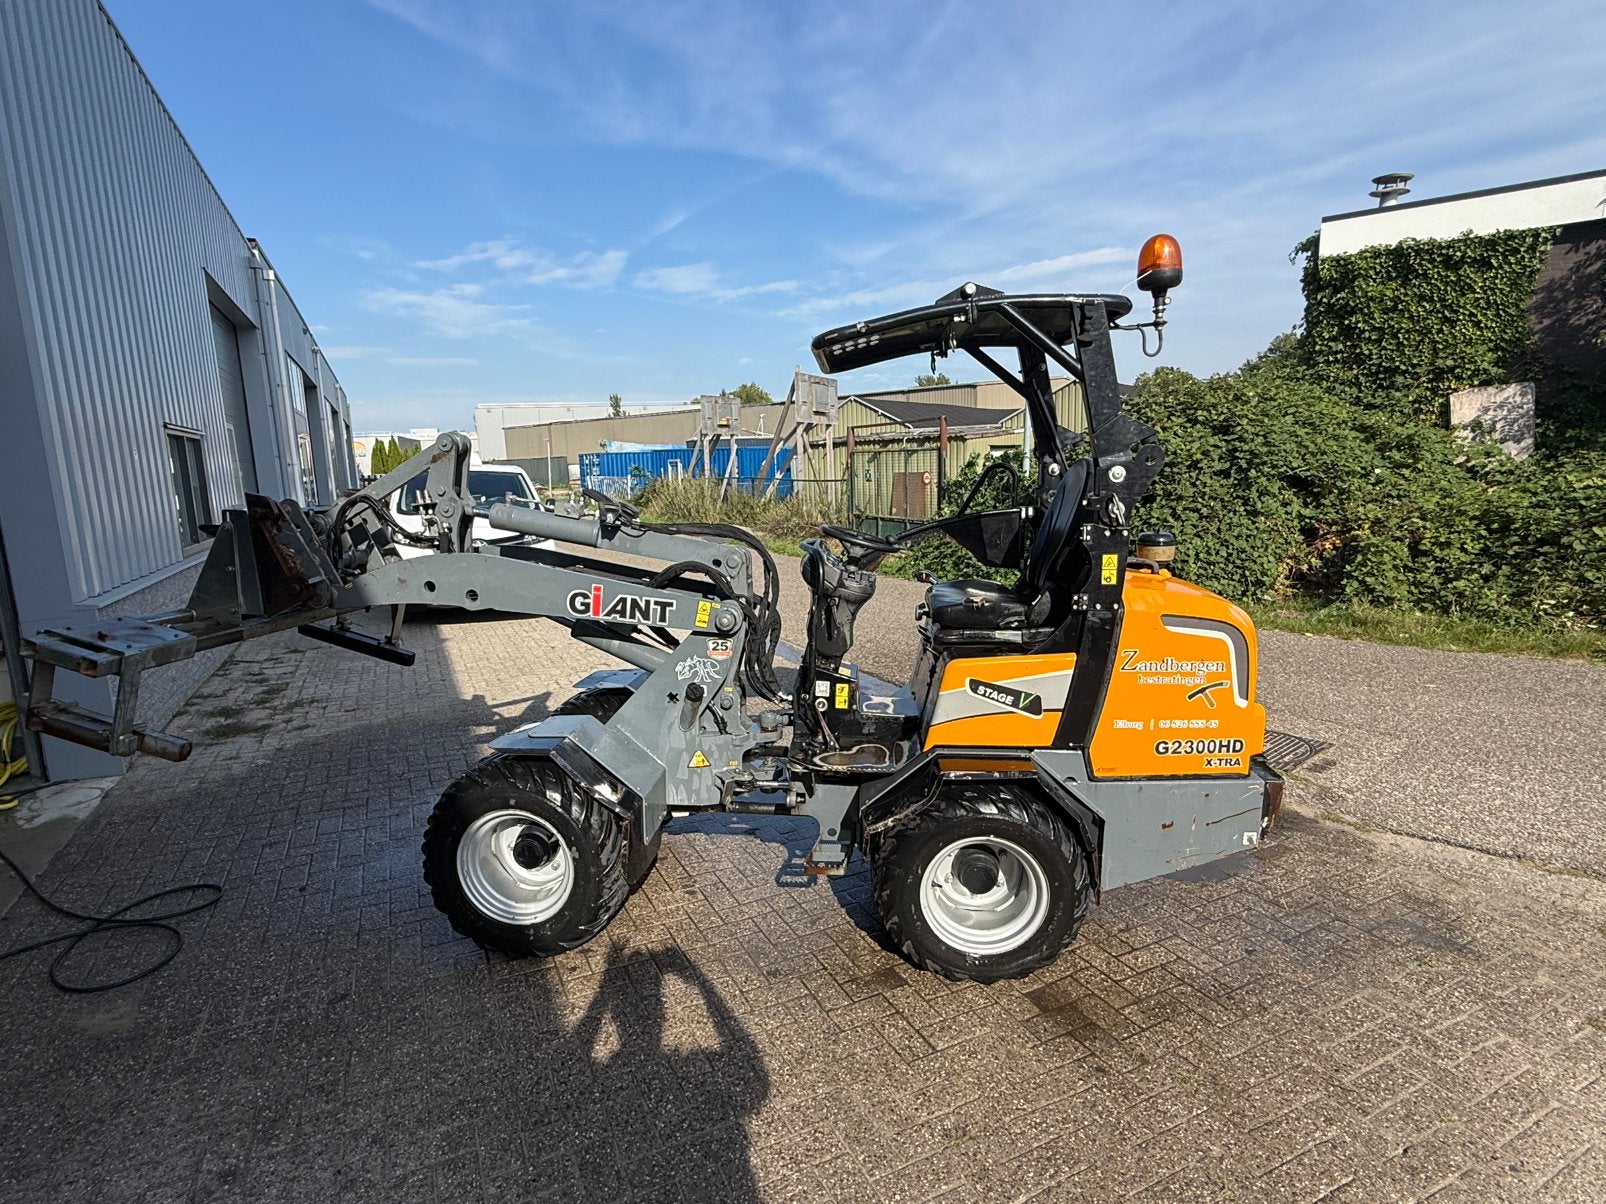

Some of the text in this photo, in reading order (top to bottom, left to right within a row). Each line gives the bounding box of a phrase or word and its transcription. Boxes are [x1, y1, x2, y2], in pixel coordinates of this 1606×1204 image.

[711, 641, 729, 651] 25
[1120, 650, 1226, 674] Zandbergen
[1139, 675, 1205, 686] bestratingen
[977, 685, 1014, 705] STAGE
[1113, 720, 1143, 730] Elburg
[1159, 720, 1170, 728] 06
[1155, 740, 1244, 756] G2300HD
[1203, 758, 1242, 768] X-TRA
